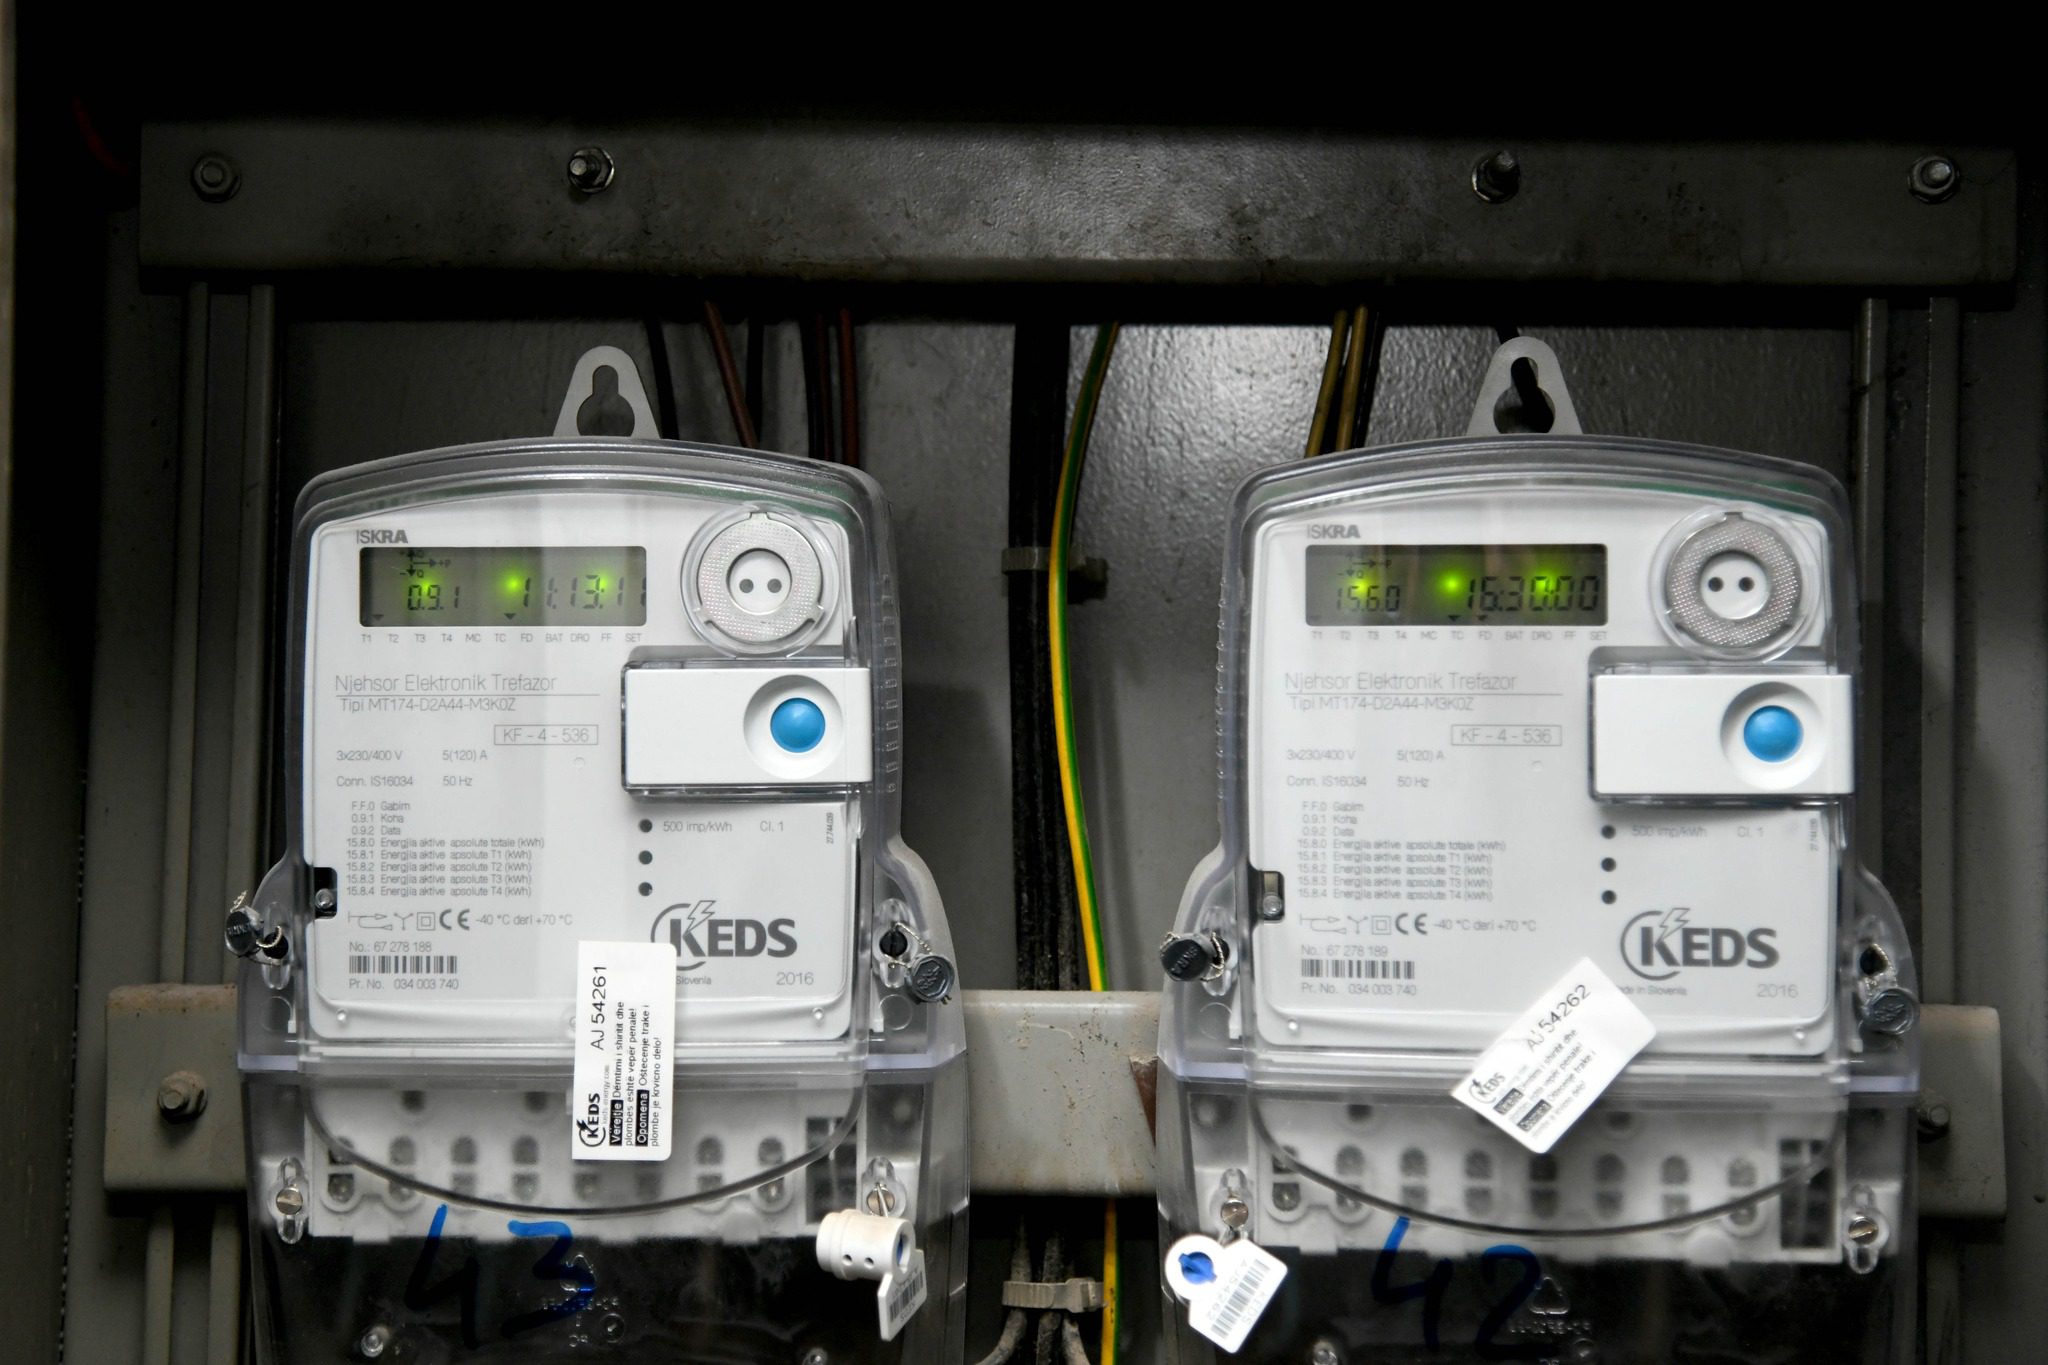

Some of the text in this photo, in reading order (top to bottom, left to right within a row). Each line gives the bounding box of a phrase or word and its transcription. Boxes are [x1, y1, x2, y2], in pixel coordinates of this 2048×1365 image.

[356, 530, 408, 544] ISKRA
[1306, 525, 1360, 539] ISKRA
[407, 585, 460, 610] 0.9.1
[362, 633, 371, 643] T1
[388, 633, 399, 643] T2
[415, 633, 426, 643] T3
[441, 633, 452, 643] T4
[465, 633, 481, 643] MC
[495, 633, 506, 643] TC
[521, 633, 533, 643] FD
[546, 633, 563, 643] BAT
[601, 633, 612, 643] FF
[625, 633, 642, 643] SET
[335, 674, 557, 694] Njehsor Elektronik Trefazor
[1285, 673, 1517, 693] Njehsor Elektronik Trefazor
[341, 698, 364, 713] Tipi
[503, 728, 589, 742] KF 4 536
[1461, 729, 1551, 743] KF 4 536
[336, 751, 403, 761] 3x230/400 V
[443, 751, 488, 762] 5(120) A
[337, 776, 414, 787] Conn. IS16034
[443, 776, 473, 787] 50 Hz
[1397, 776, 1429, 787] 50 Hz
[380, 814, 404, 823] Koha
[380, 826, 401, 835] Data
[663, 821, 732, 833] 500 imp/kWh
[419, 838, 445, 847] aktive
[450, 838, 488, 849] apsolute
[419, 850, 445, 859] aktive
[450, 850, 488, 861] apsolute
[491, 850, 502, 859] T1
[419, 863, 445, 872] aktive
[450, 863, 488, 874] apsolute
[491, 863, 502, 872] T2
[419, 875, 445, 884] aktive
[450, 875, 488, 886] apsolute
[491, 875, 502, 884] T3
[419, 887, 445, 896] aktive
[450, 887, 488, 898] apsolute
[491, 887, 502, 896] T4
[513, 915, 533, 925] deri
[670, 907, 798, 957] KEDS
[1641, 908, 1780, 969] KEDS
[373, 942, 387, 952] 67
[389, 942, 410, 952] 278
[413, 942, 432, 952] 188
[1326, 945, 1340, 956] 67
[1343, 945, 1365, 956] 278
[394, 979, 414, 990] 034
[418, 979, 436, 990] 003
[439, 979, 459, 990] 740
[776, 972, 814, 986] 2016
[1349, 983, 1370, 994] 034
[1373, 983, 1393, 994] 003
[1396, 983, 1417, 994] 740
[1757, 984, 1799, 997] 2016
[590, 965, 607, 1051] AJ 54261
[616, 1001, 624, 1020] dhe
[1538, 983, 1592, 1034] 54262
[628, 1008, 637, 1043] penale!
[641, 1010, 650, 1035] trake
[652, 1036, 662, 1060] delo!
[650, 1100, 662, 1109] je
[578, 1092, 601, 1138] KEDS
[636, 1093, 649, 1144] Opomena
[649, 1111, 660, 1147] plombe
[405, 1203, 596, 1349] 43
[1371, 1216, 1545, 1359] 42
